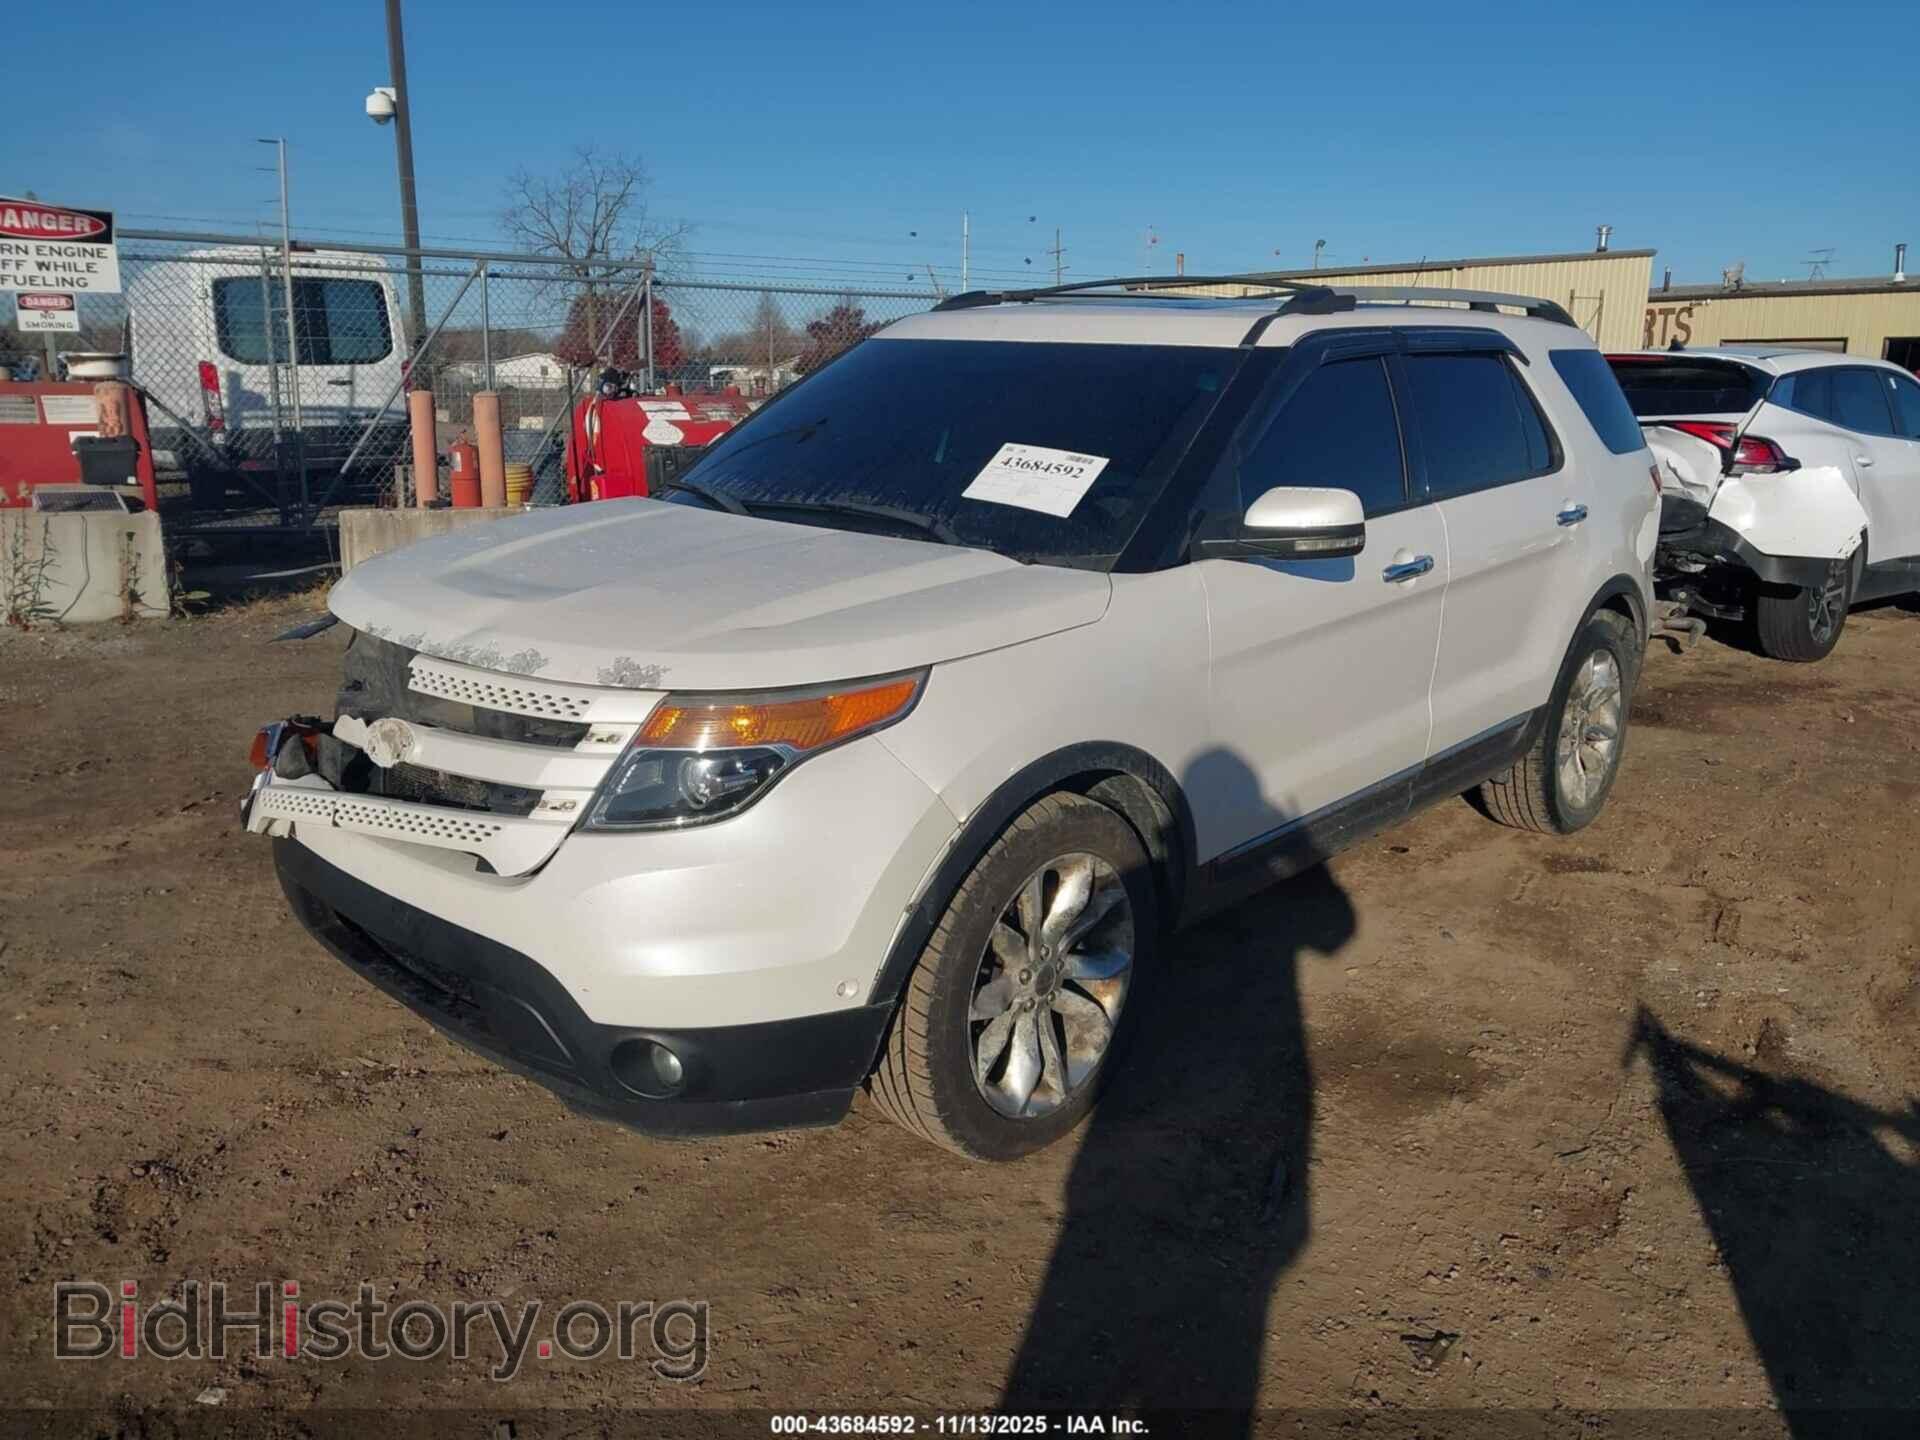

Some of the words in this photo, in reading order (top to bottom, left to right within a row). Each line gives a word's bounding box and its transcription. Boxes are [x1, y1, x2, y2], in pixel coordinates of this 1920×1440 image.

[0, 207, 91, 233] ANGER
[36, 245, 108, 259] ENGINE
[36, 260, 99, 274] WHILE
[0, 274, 89, 288] FUELING
[40, 312, 55, 320] NO
[25, 321, 74, 329] SMOKING
[1001, 456, 1084, 479] 43684592
